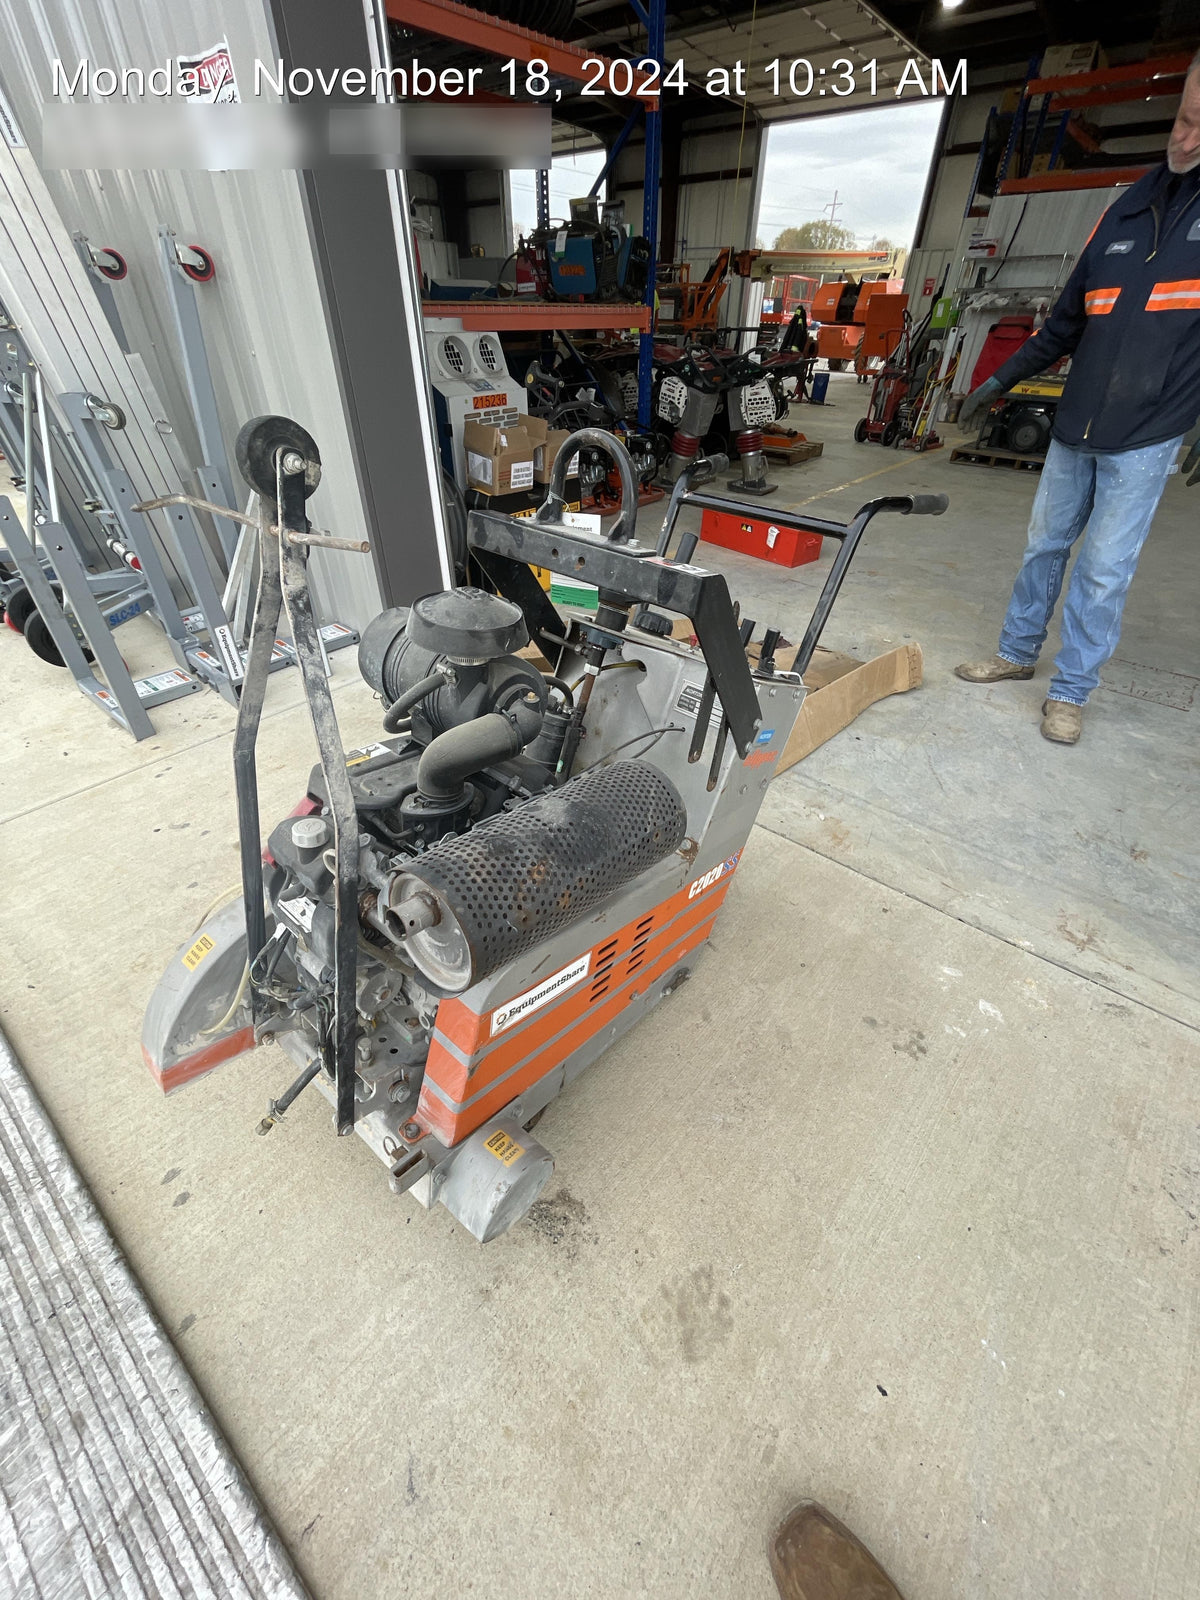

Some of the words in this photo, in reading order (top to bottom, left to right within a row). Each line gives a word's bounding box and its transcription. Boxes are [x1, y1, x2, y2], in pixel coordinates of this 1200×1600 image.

[473, 393, 507, 409] 215236
[109, 602, 141, 627] SLC-24
[221, 634, 239, 677] EquipmentShare
[688, 862, 724, 900] C2020
[508, 964, 586, 1018] EquipmentShare
[494, 1141, 505, 1151] KEEP
